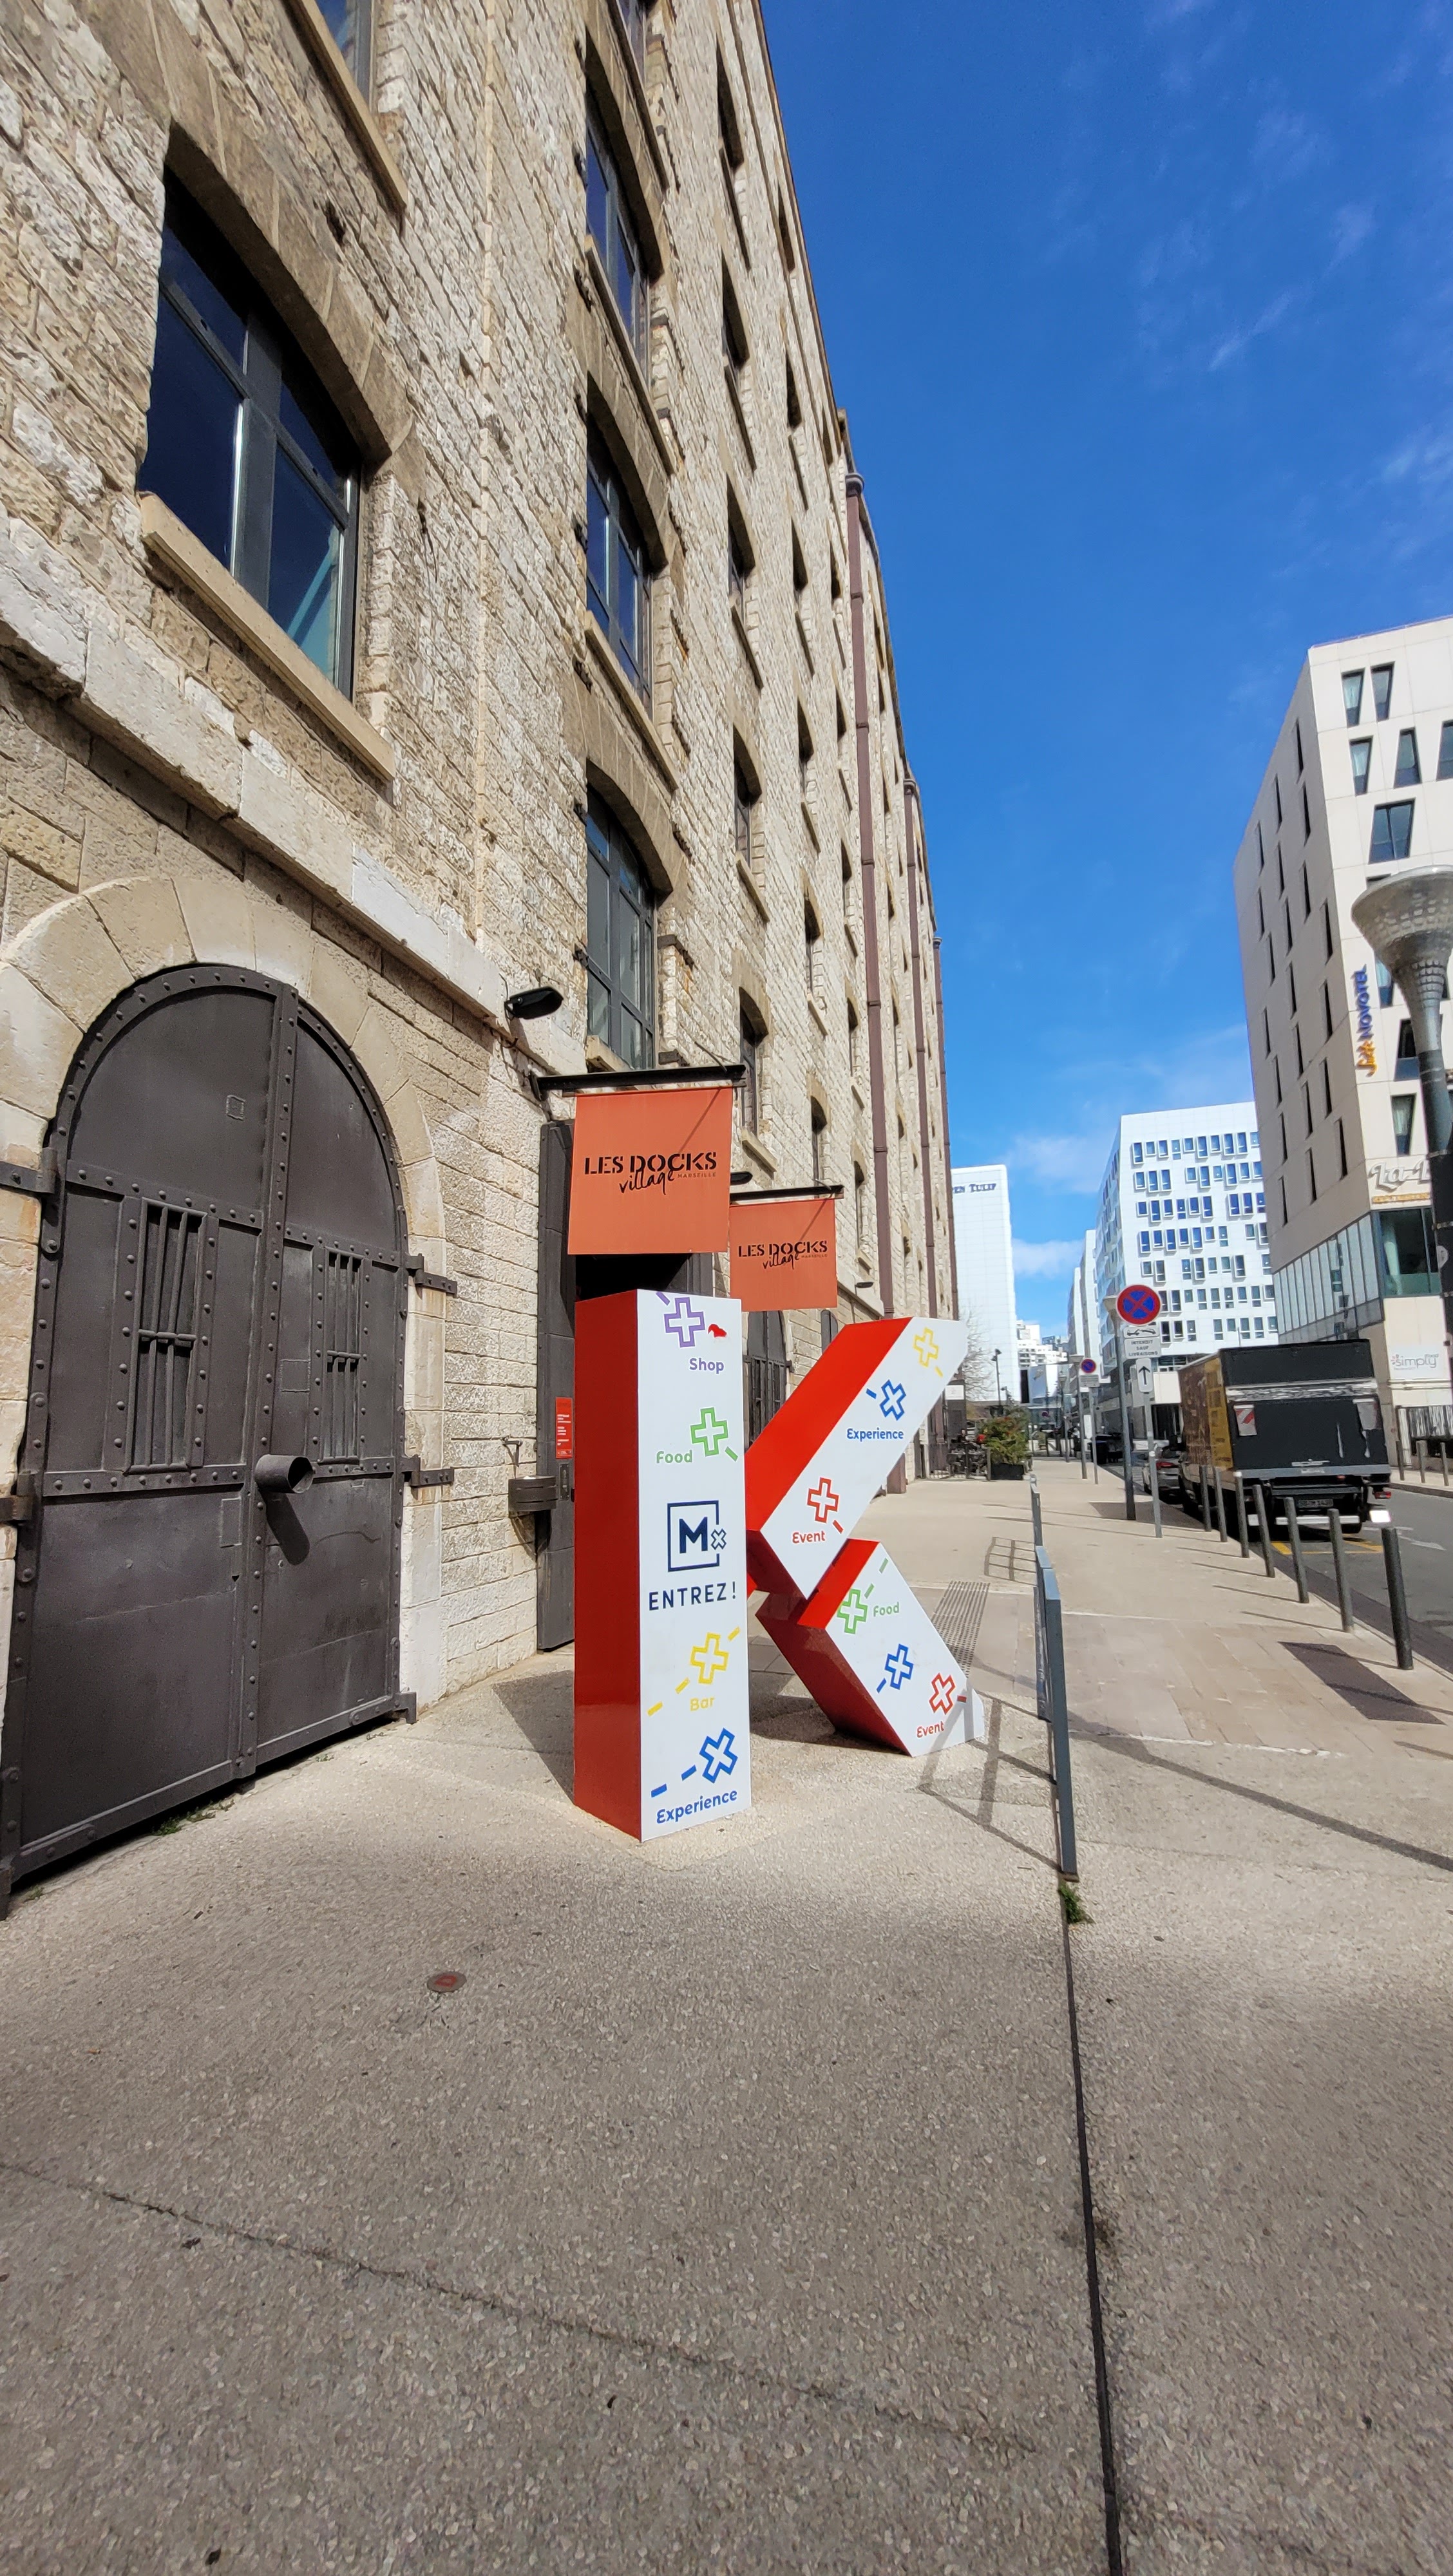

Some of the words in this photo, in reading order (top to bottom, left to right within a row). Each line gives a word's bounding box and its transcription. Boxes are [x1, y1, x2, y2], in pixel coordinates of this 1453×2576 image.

[1353, 964, 1374, 1041] NOVOTEL
[584, 1156, 623, 1175] LES
[630, 1151, 717, 1173] DOCKS
[619, 1169, 675, 1195] village
[738, 1244, 765, 1257] LES
[768, 1240, 828, 1256] DOCKS
[762, 1252, 800, 1269] village
[689, 1358, 725, 1374] Shop
[1396, 1354, 1436, 1368] simply
[846, 1427, 904, 1442] Experience
[656, 1450, 692, 1464] Food
[792, 1530, 826, 1544] Event
[873, 1602, 899, 1617] Food
[690, 1697, 714, 1711] Bar
[916, 1720, 945, 1738] Event
[656, 1790, 737, 1824] Experience
